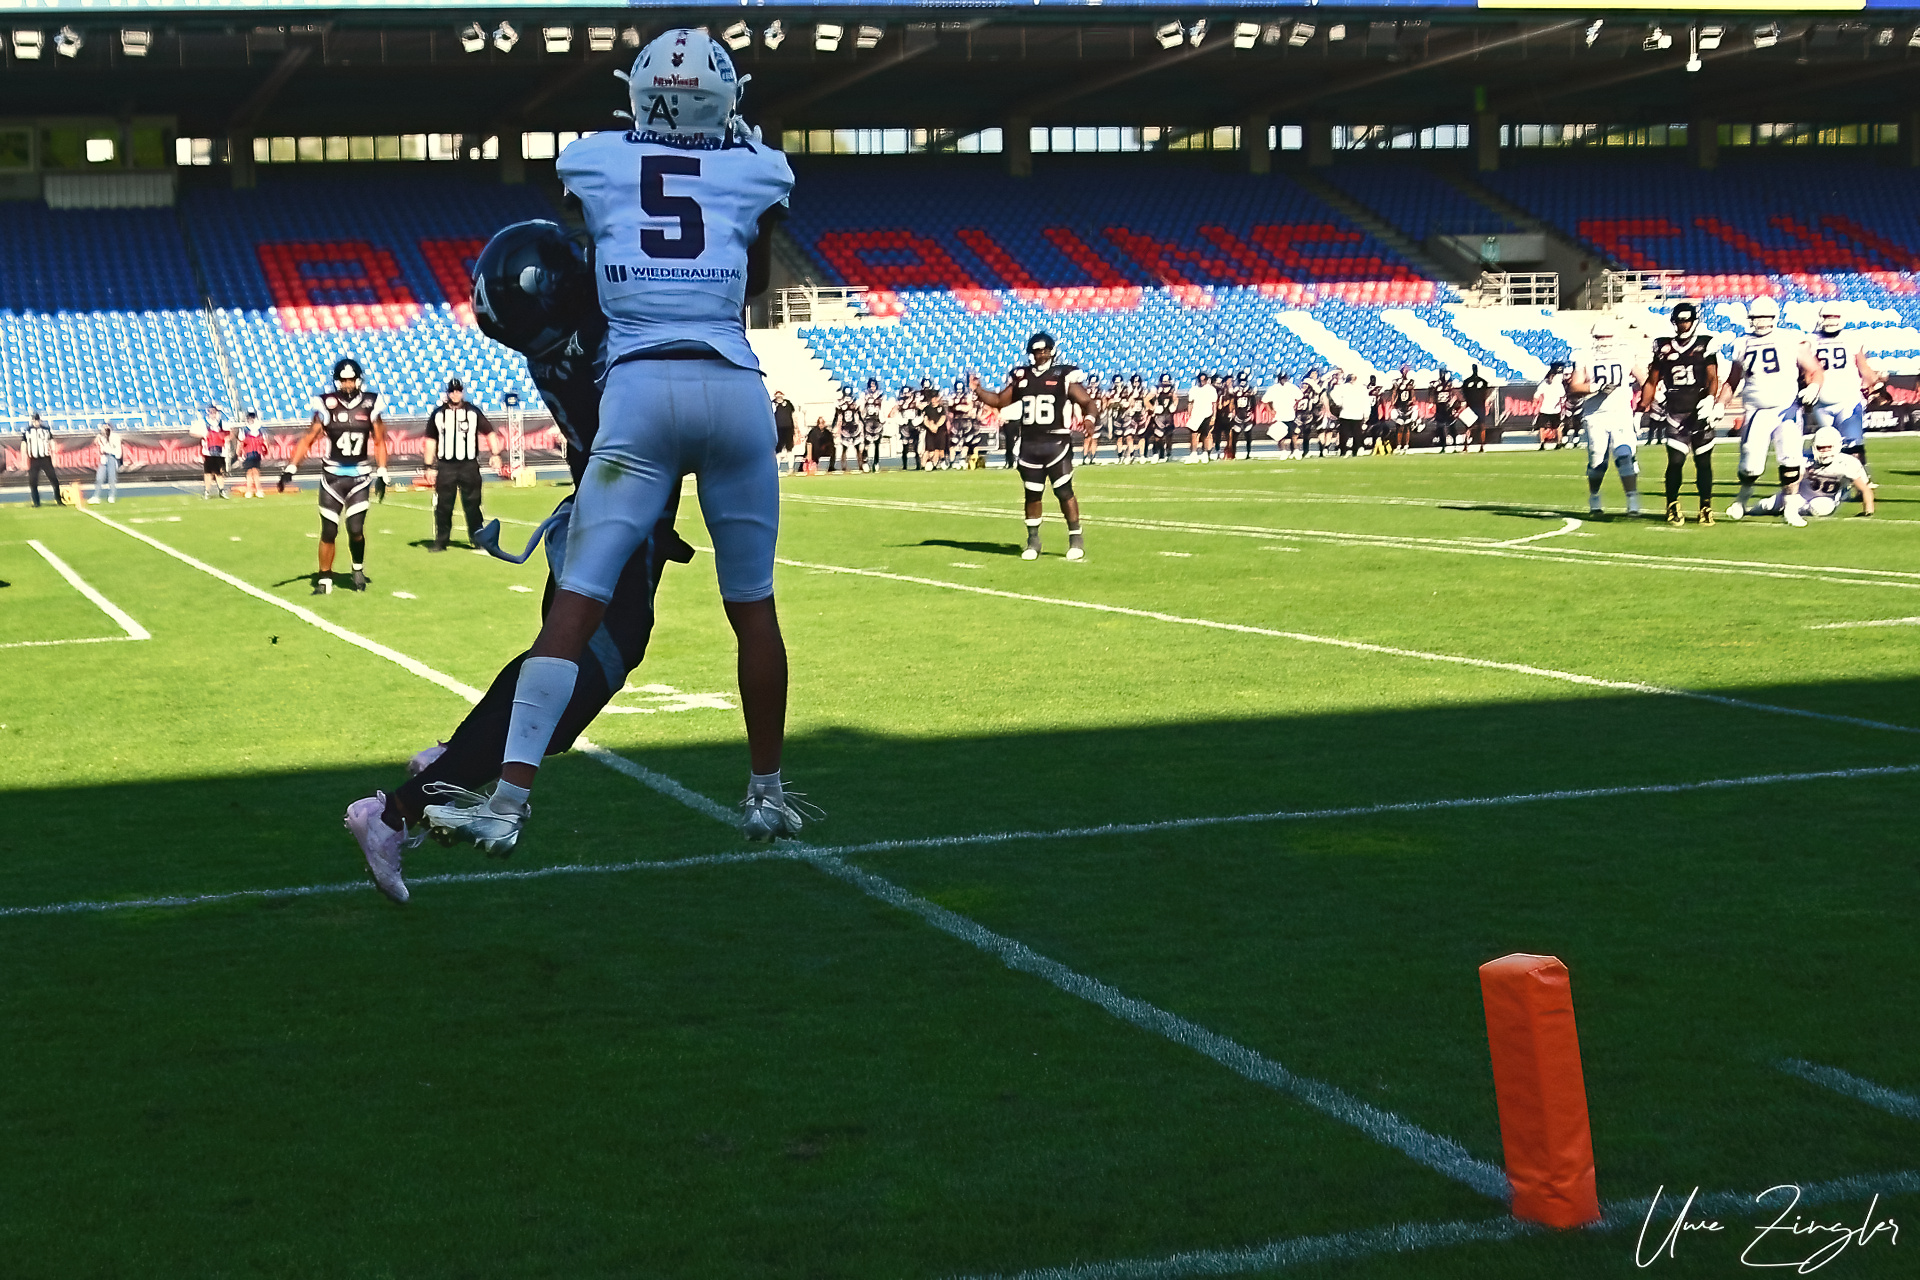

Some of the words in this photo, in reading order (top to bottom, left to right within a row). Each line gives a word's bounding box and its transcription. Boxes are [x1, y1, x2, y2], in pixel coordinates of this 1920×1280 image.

[640, 155, 705, 260] 5
[1671, 364, 1696, 386] 21
[1743, 347, 1781, 378] 79
[336, 431, 364, 456] 47
